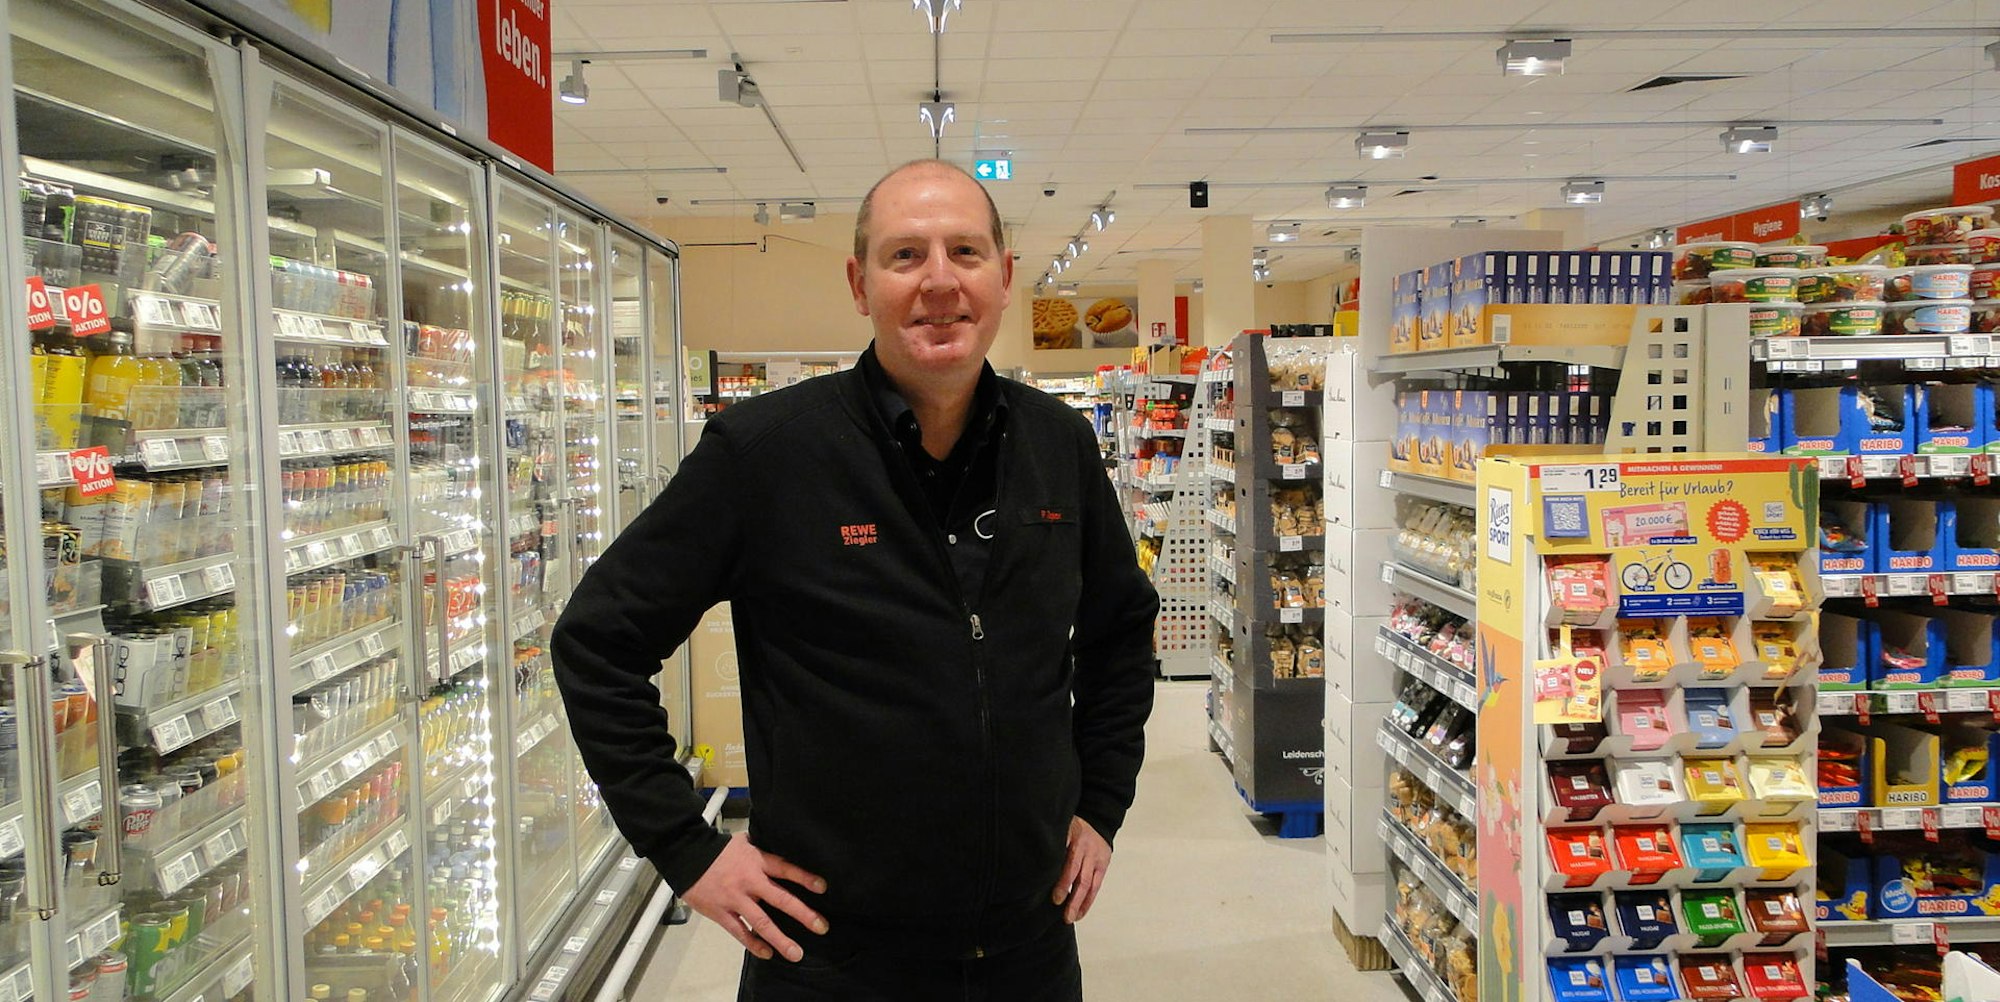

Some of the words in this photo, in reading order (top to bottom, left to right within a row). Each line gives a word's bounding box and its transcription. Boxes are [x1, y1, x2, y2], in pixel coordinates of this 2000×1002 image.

[496, 0, 545, 89] leben.
[1753, 219, 1783, 237] Hygiene
[67, 291, 102, 319] %
[75, 317, 107, 333] AKTION
[1798, 440, 1834, 450] HARIBO
[1860, 438, 1903, 450] HARIBO
[1932, 437, 1968, 447] HARIBO
[1627, 465, 1672, 473] MITMACHEN
[1680, 463, 1723, 471] GEWINNEN!
[1584, 468, 1617, 489] 1.29
[82, 478, 114, 493] AKTION
[1619, 481, 1656, 499] Bereit
[1658, 480, 1679, 502] für
[1683, 479, 1734, 496] Urlaub?
[841, 524, 877, 537] REWE
[1489, 527, 1510, 547] SPORT
[844, 536, 877, 546] Ziegler
[1823, 557, 1865, 571] HARIBO
[1890, 555, 1933, 569] HARIBO
[1956, 553, 2000, 567] HARIBO
[1577, 667, 1594, 675] NEU
[1951, 669, 1986, 681] HARIBO
[1886, 672, 1922, 684] HARIBO
[1819, 791, 1860, 804] HARIBO
[1888, 792, 1928, 803] HARIBO
[1947, 786, 1989, 799] HARIBO
[1918, 900, 1967, 914] HARIBO
